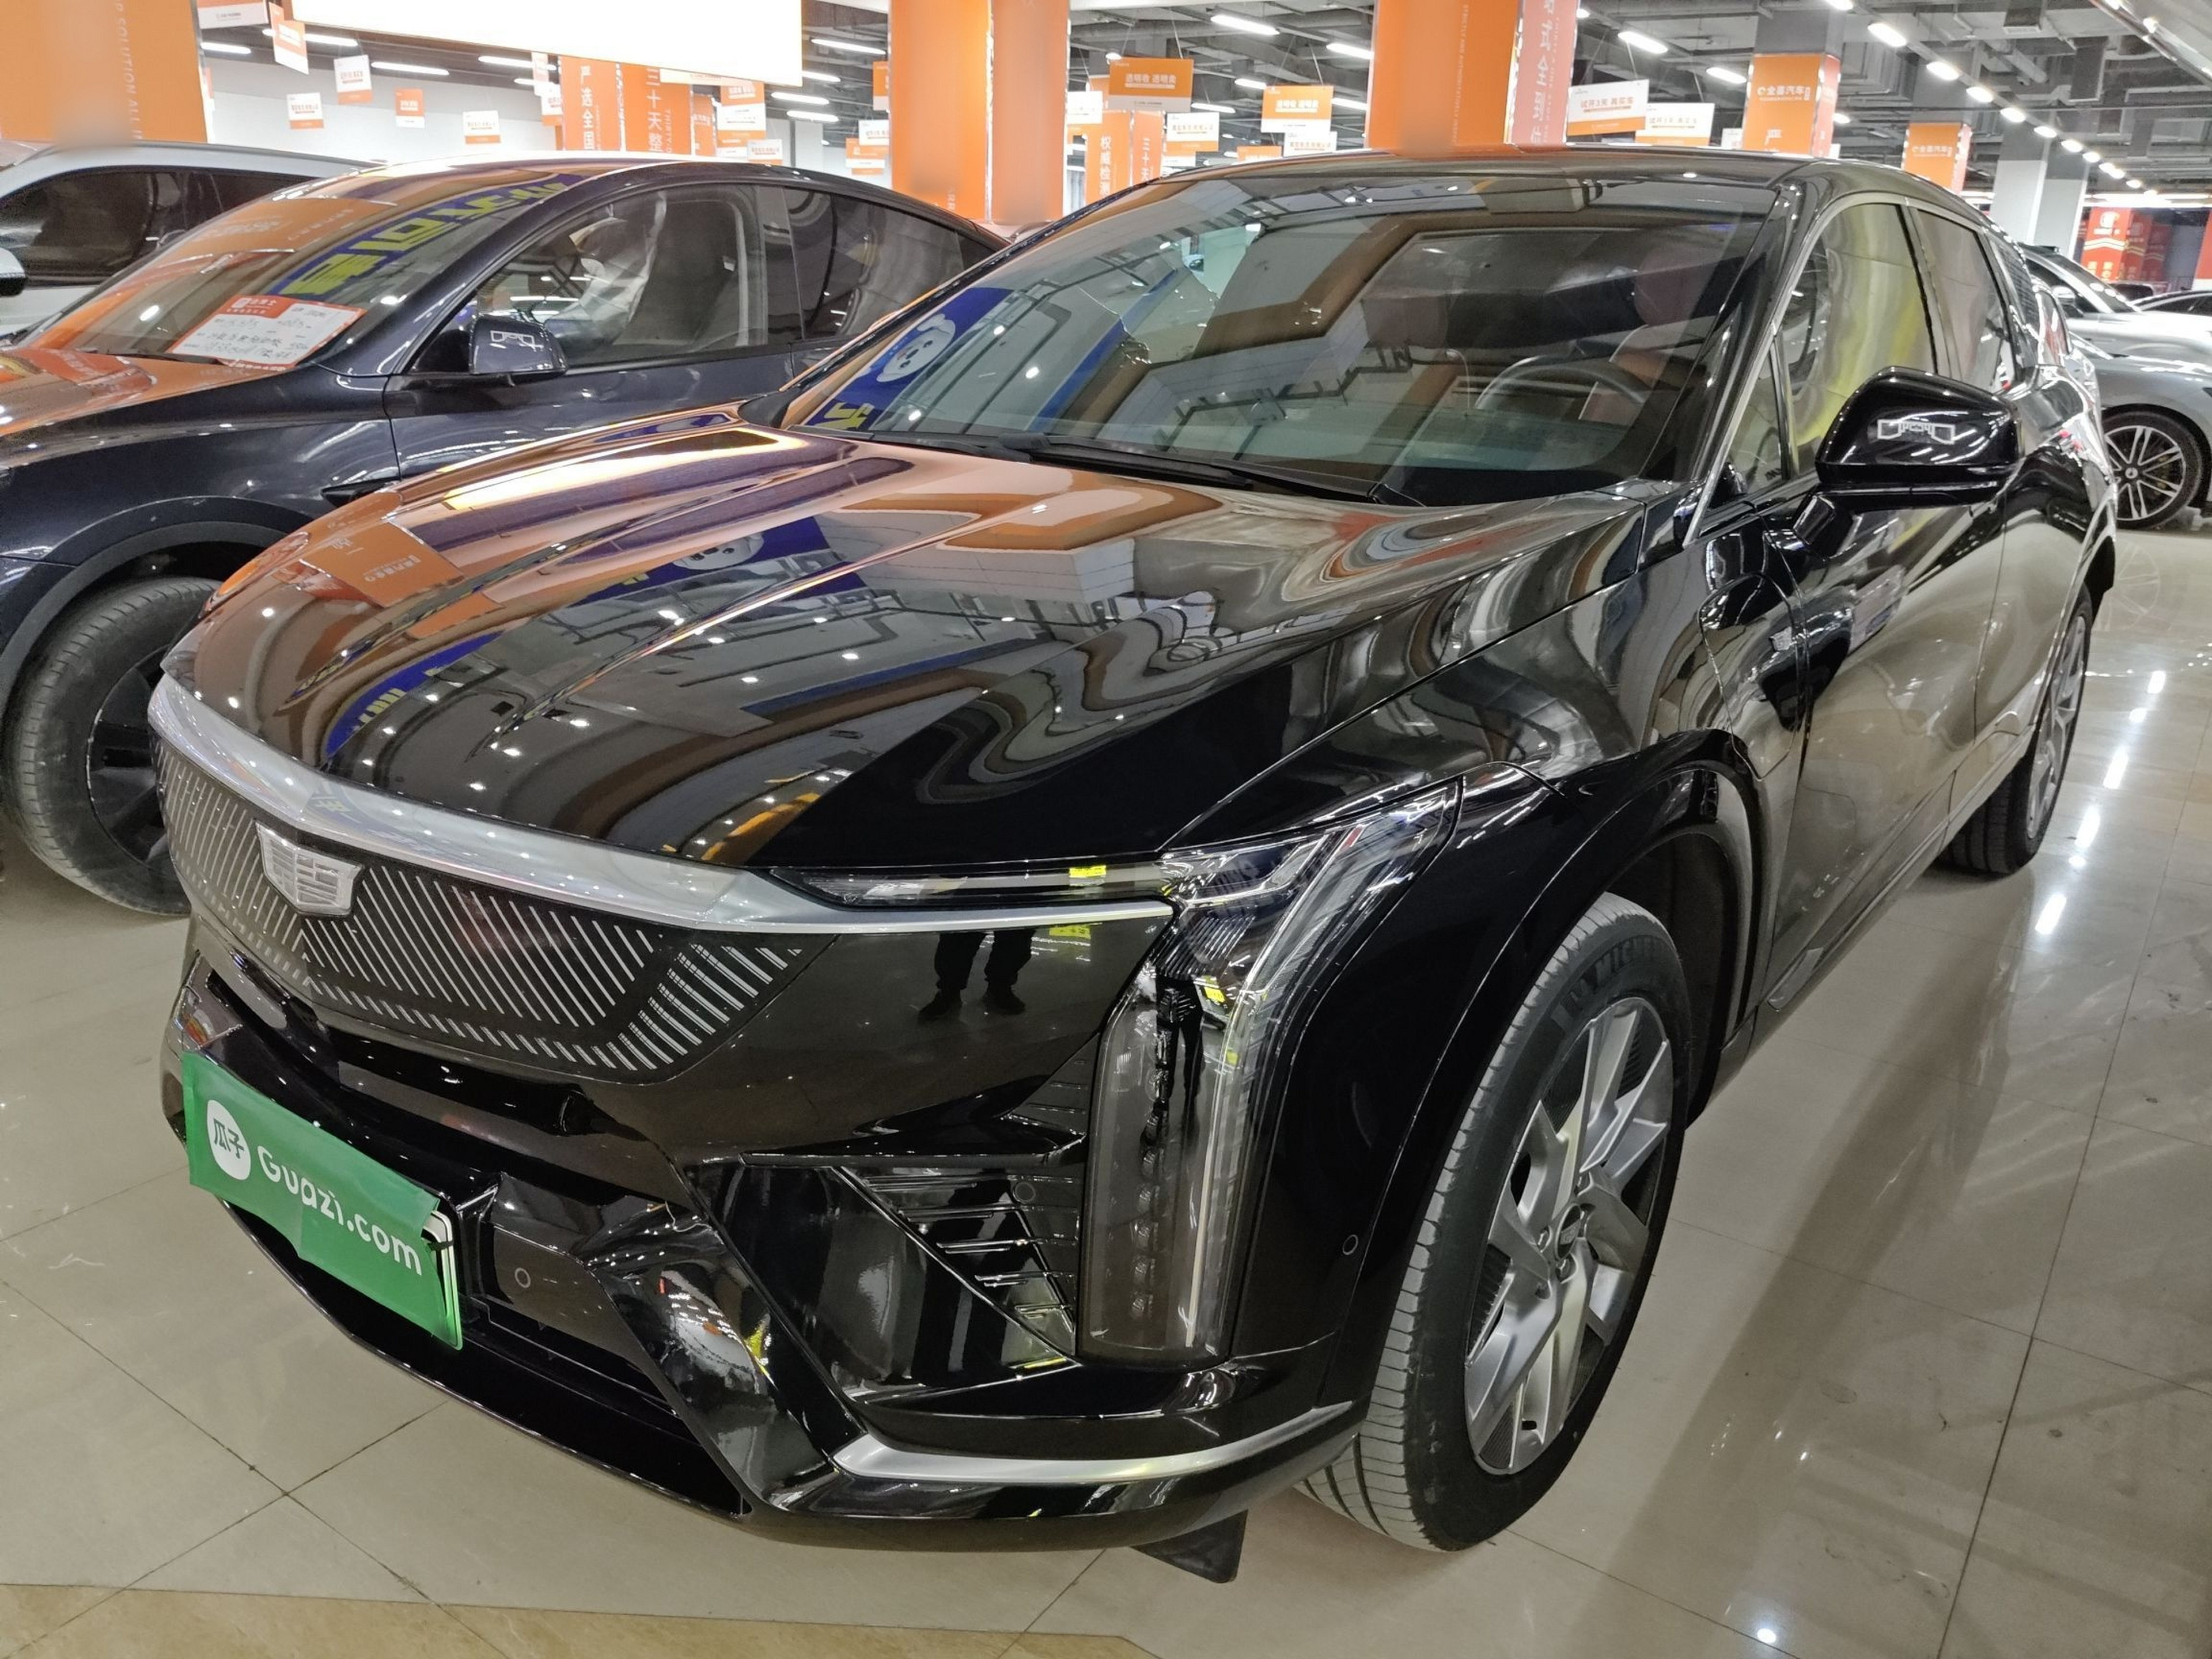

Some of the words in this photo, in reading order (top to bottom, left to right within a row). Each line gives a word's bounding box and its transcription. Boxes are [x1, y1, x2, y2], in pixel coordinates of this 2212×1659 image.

[115, 17, 137, 94] SOLUTION
[645, 67, 663, 153] 三十天整
[213, 1118, 245, 1159] 瓜子
[257, 1145, 422, 1275] Guazi.com
